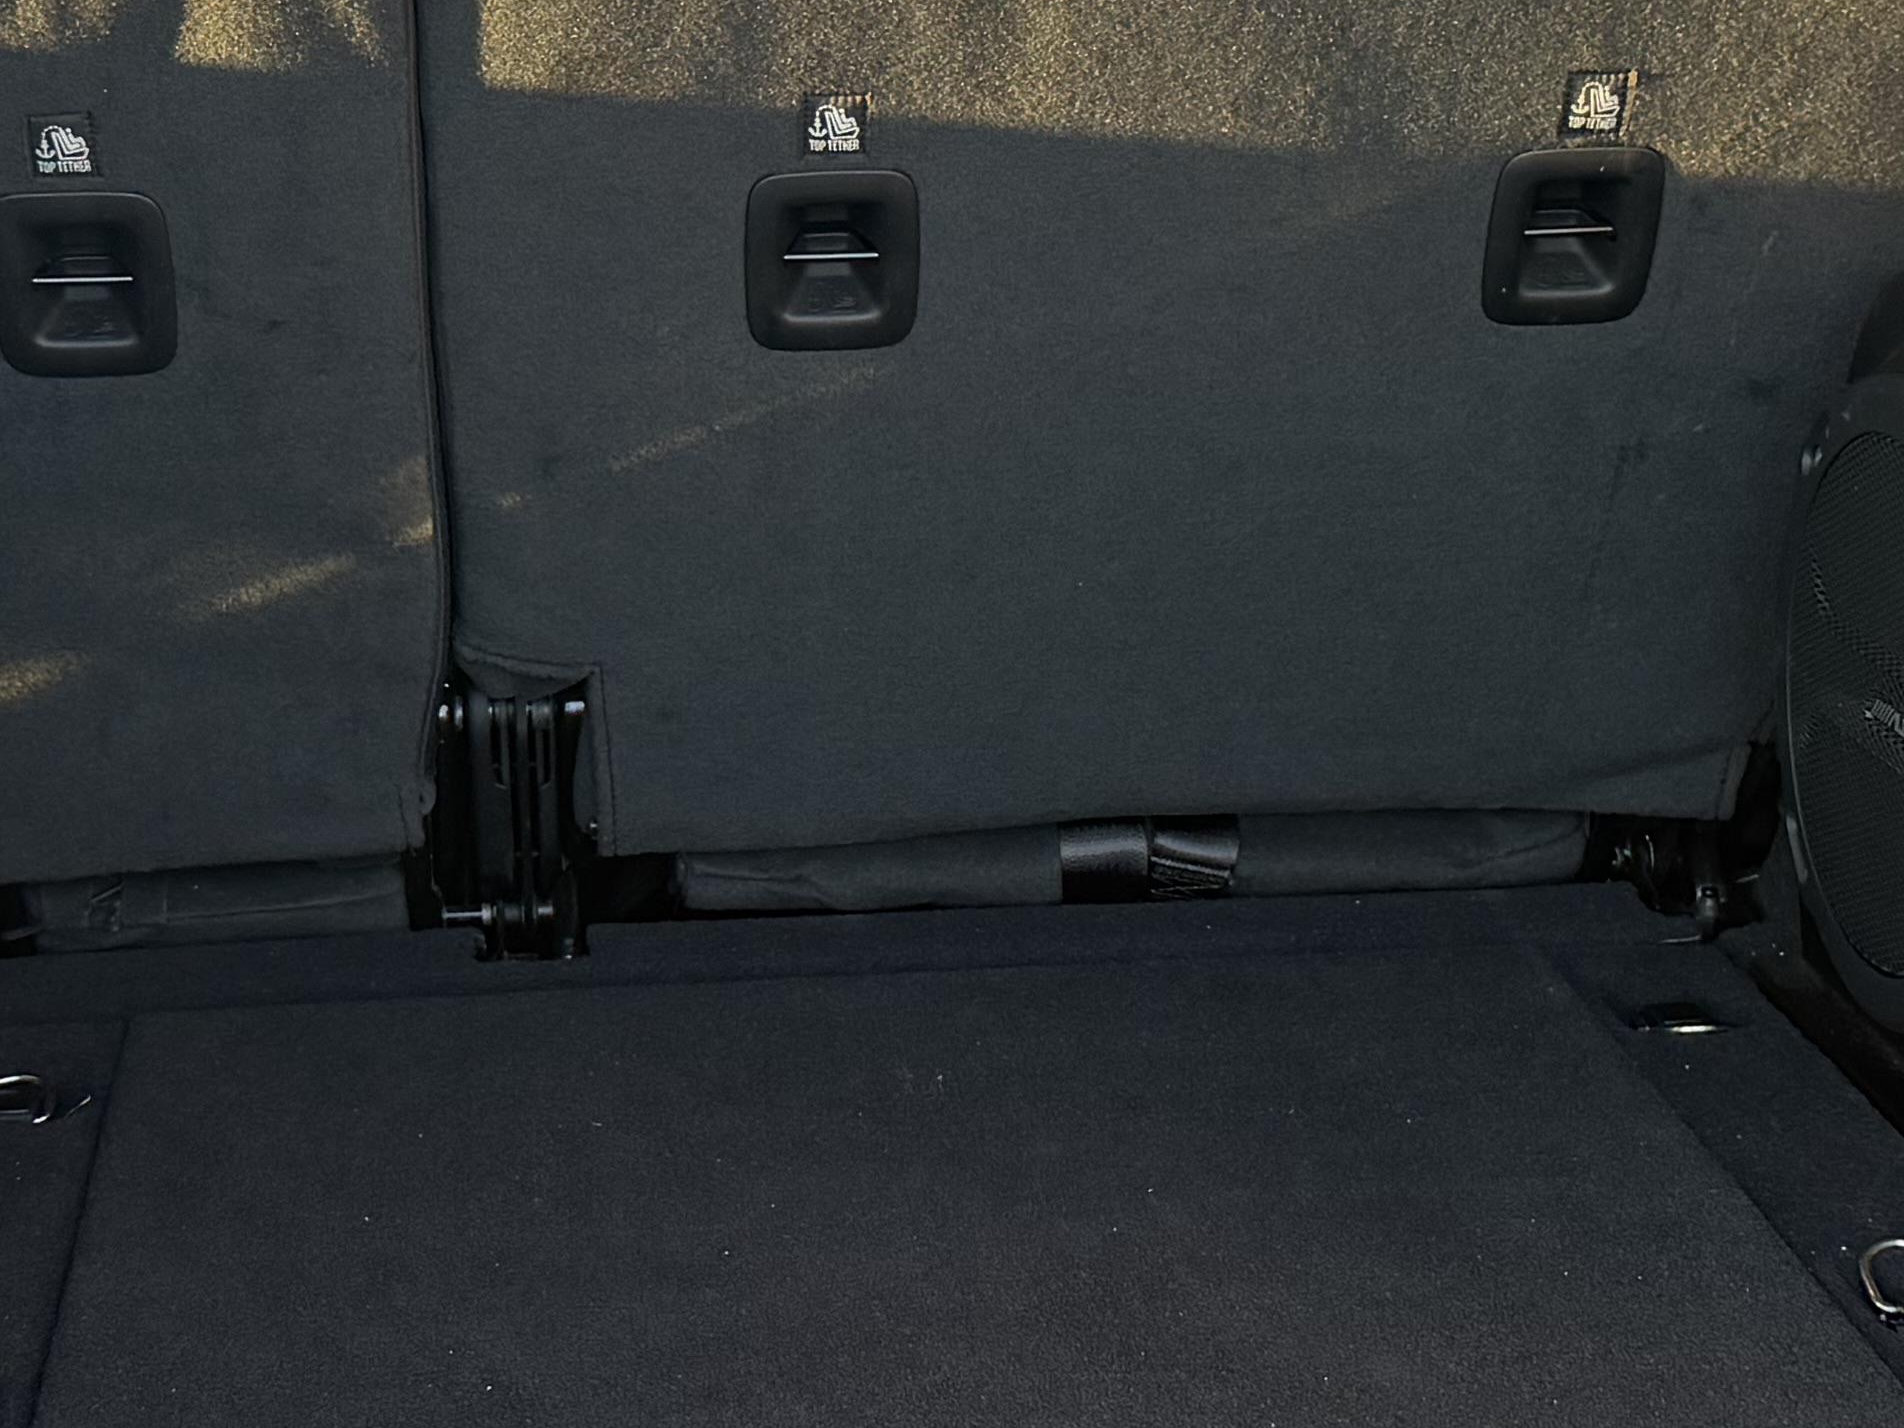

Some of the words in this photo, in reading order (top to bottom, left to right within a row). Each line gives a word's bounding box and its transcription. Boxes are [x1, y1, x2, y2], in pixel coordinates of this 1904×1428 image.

[808, 138, 827, 152] TOP
[827, 138, 860, 152] TETHER
[36, 160, 56, 173] TOP
[57, 159, 92, 173] TETHER
